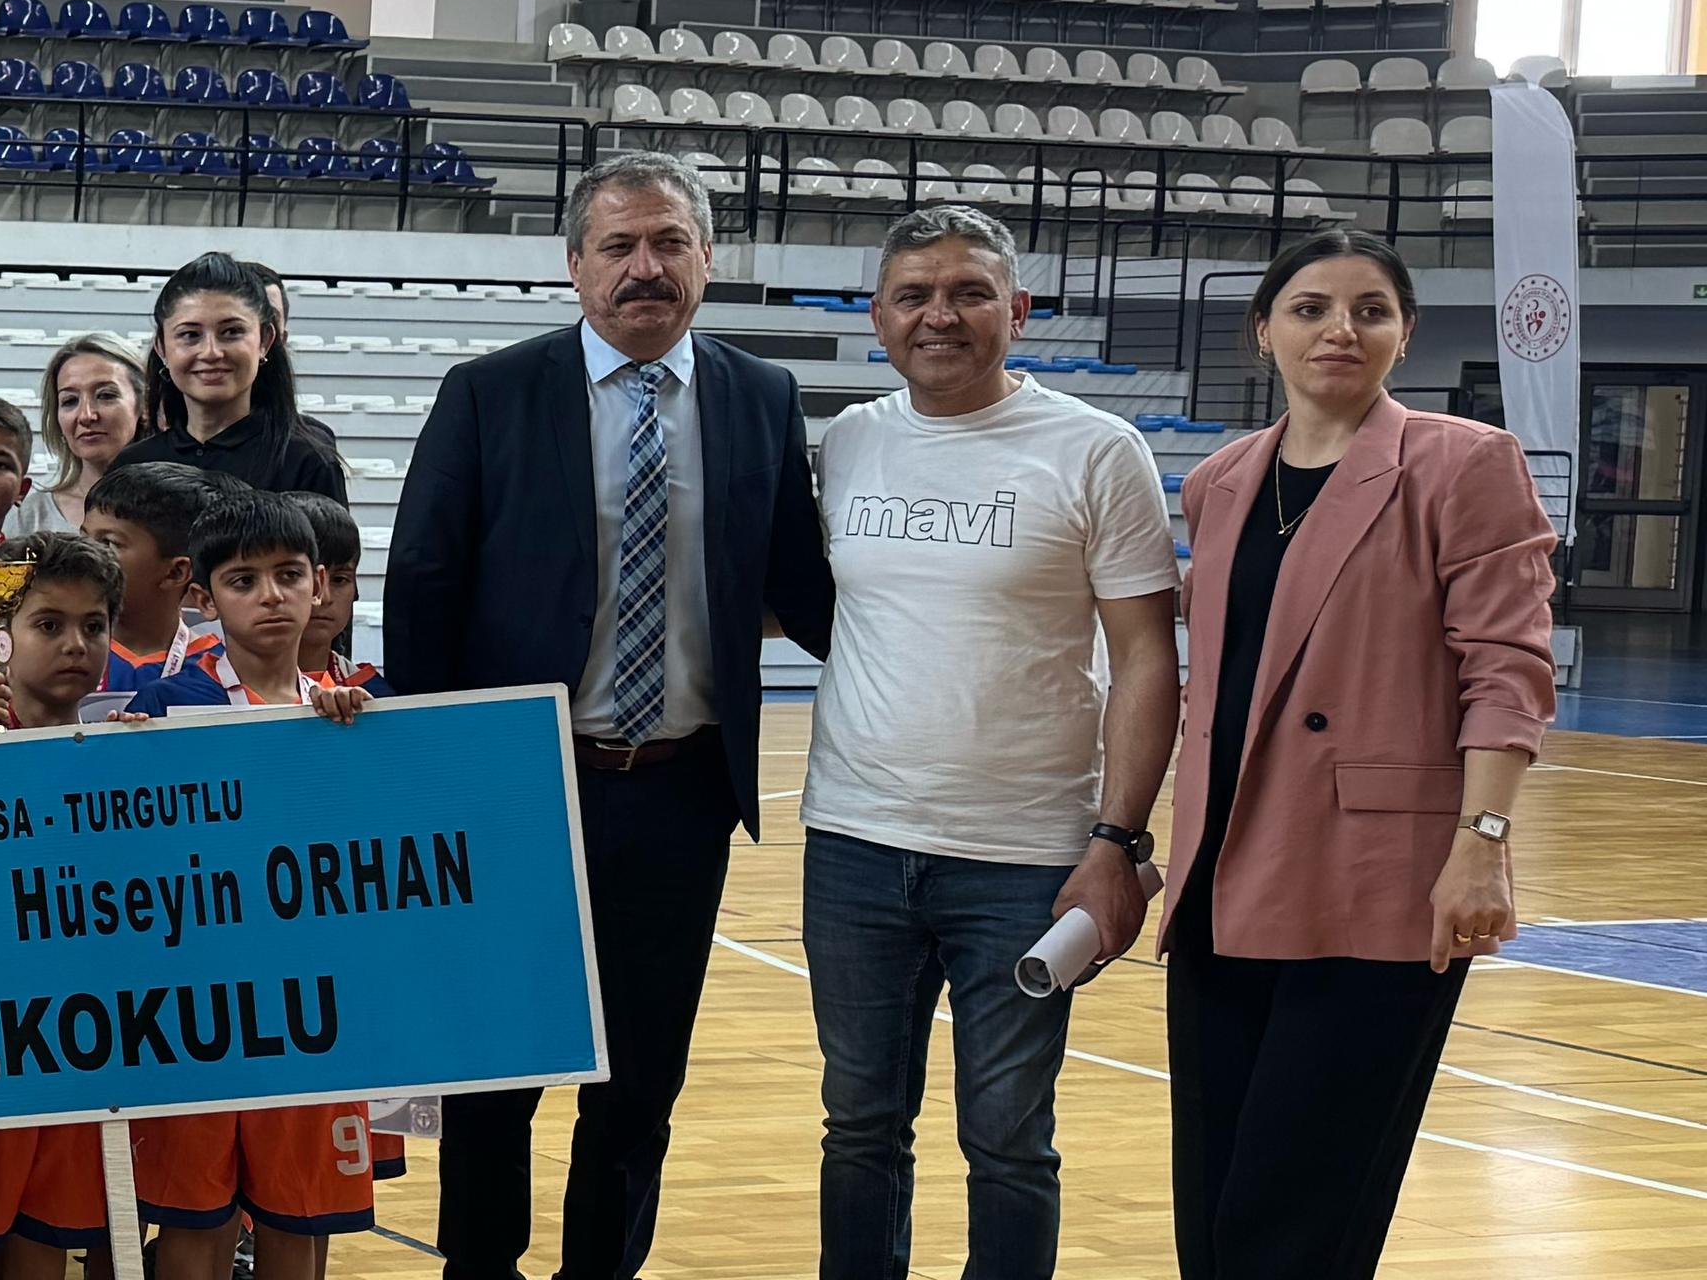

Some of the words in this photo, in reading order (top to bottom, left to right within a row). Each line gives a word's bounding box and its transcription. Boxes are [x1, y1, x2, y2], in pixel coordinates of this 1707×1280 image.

[846, 490, 1016, 548] mavi
[63, 779, 244, 835] TURGUTLU
[12, 853, 242, 949] Hüseyin
[266, 830, 474, 921] ORHAN
[332, 1115, 371, 1176] 9
